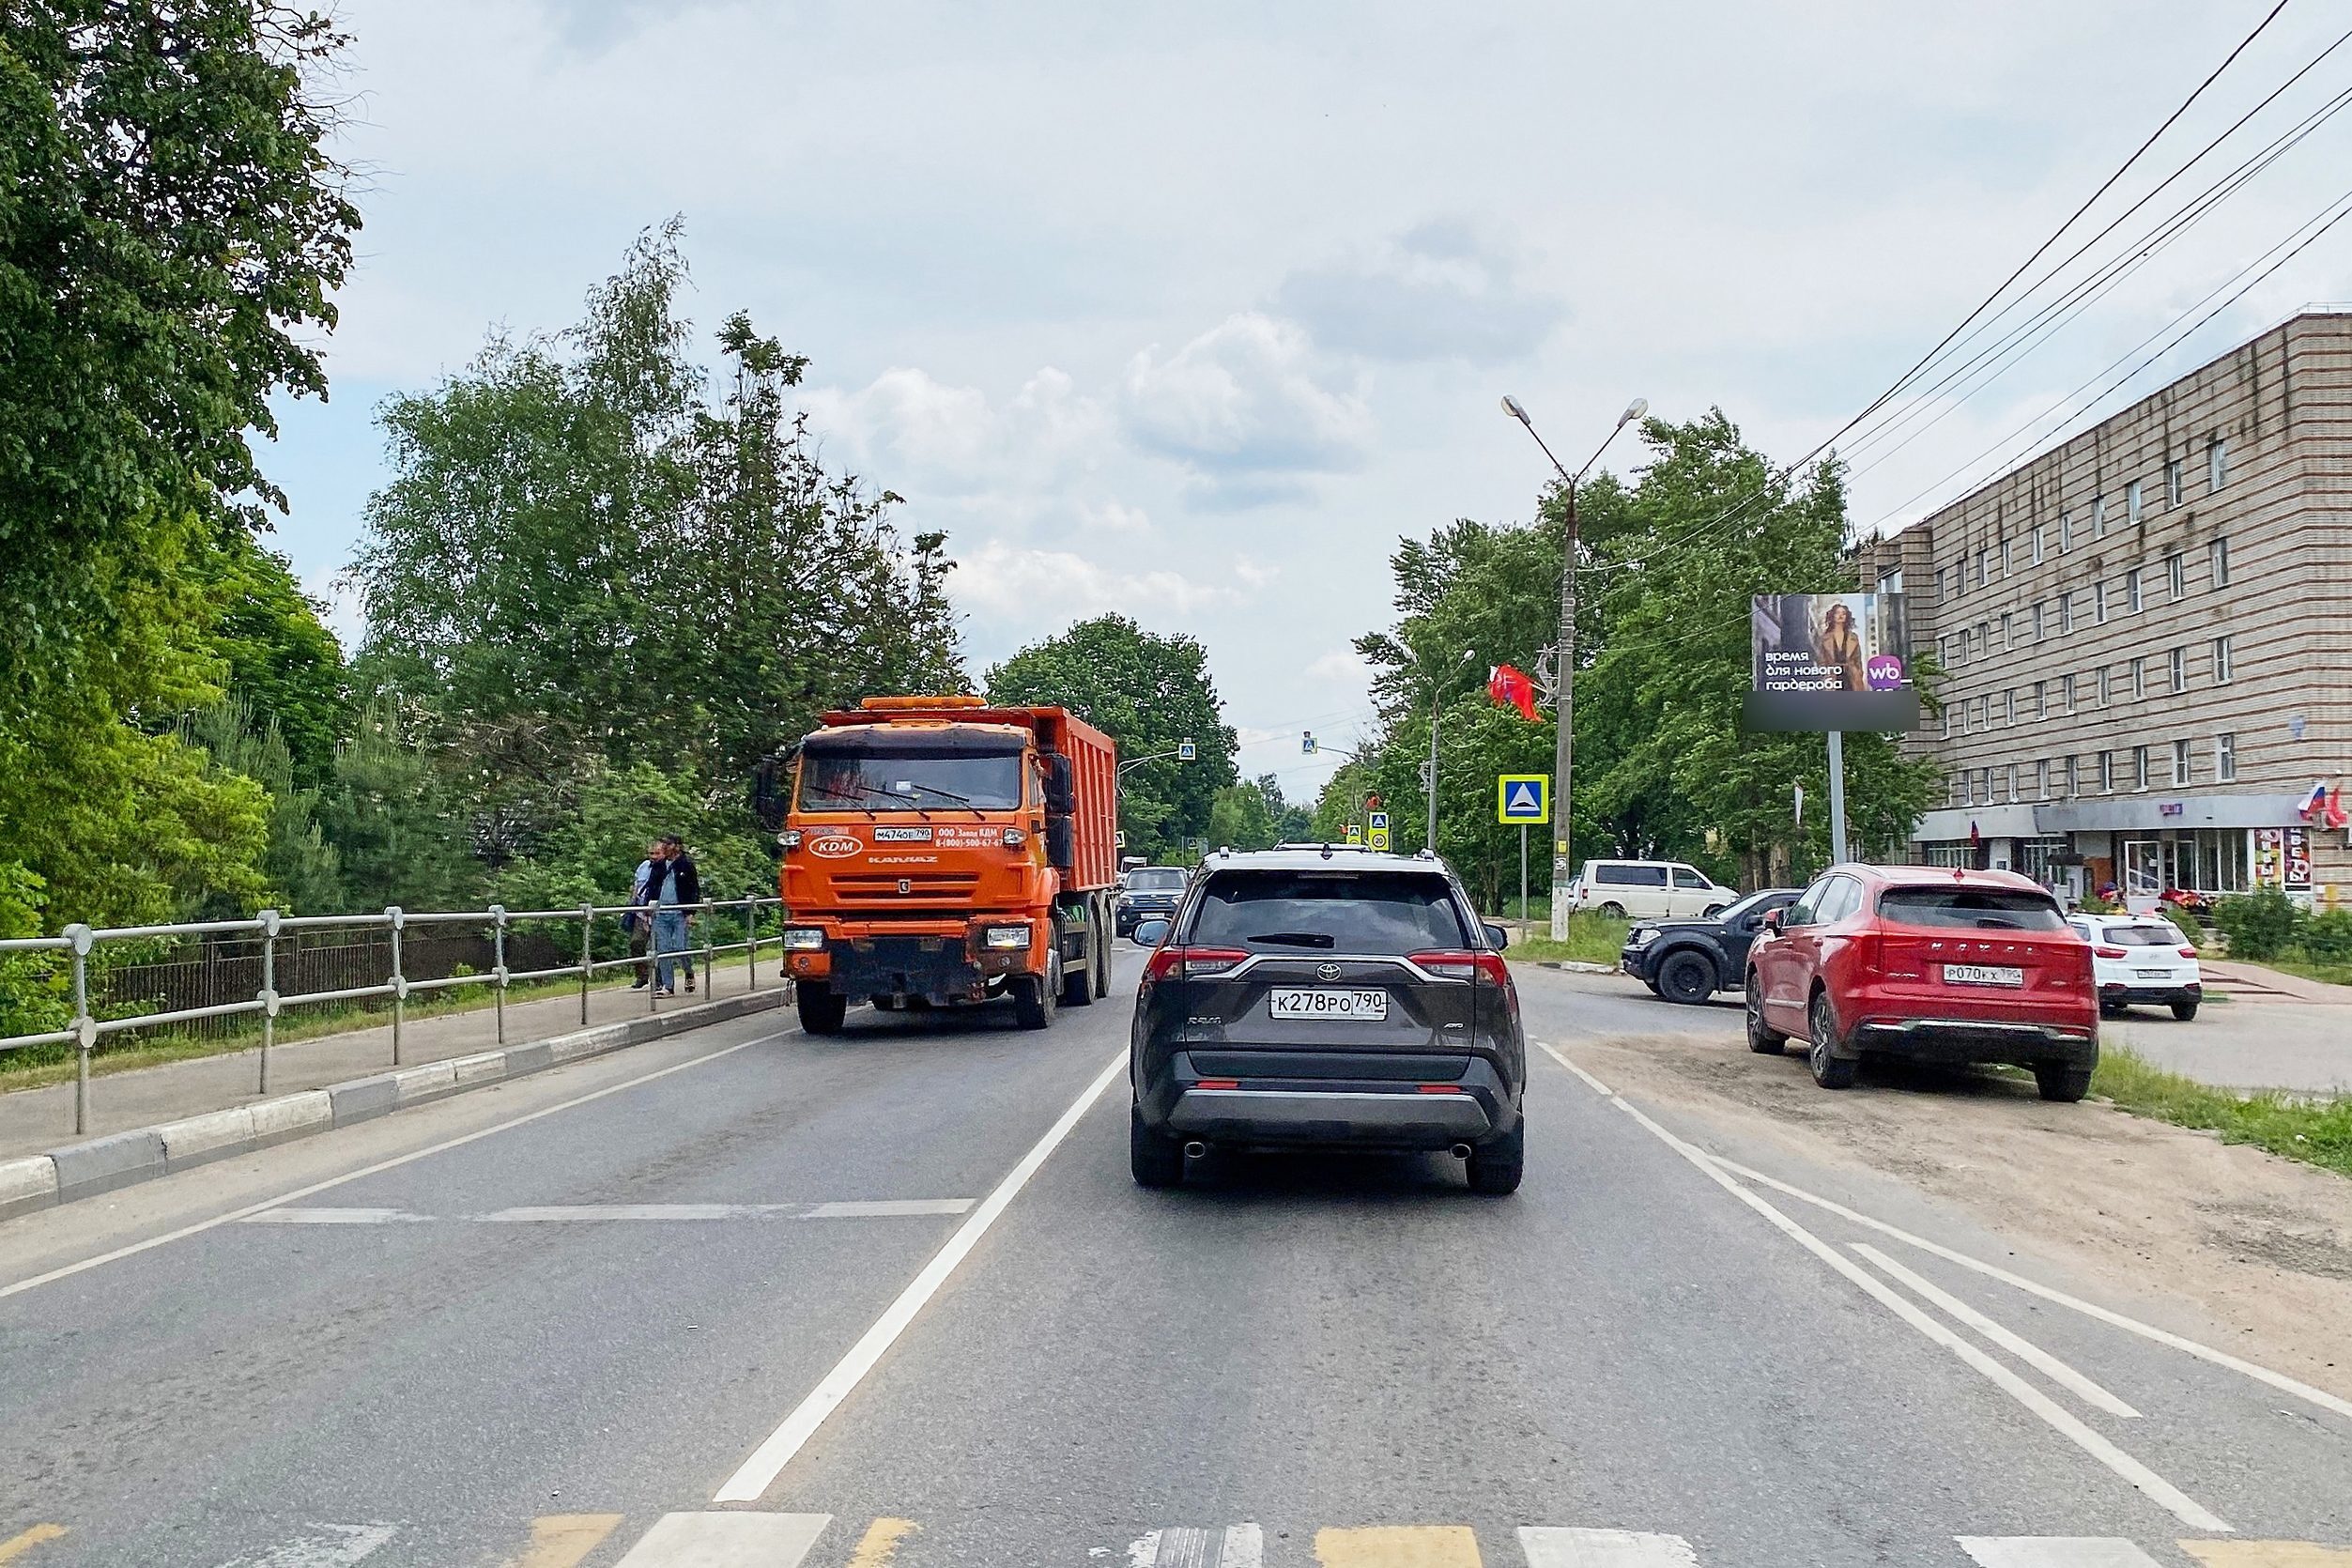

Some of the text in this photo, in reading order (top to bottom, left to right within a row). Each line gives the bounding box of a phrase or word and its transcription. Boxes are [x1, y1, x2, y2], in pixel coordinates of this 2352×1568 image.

[1765, 651, 1809, 664] время
[1765, 665, 1843, 676] для нового
[1868, 663, 1900, 680] wb
[1765, 678, 1843, 691] гардероба
[938, 828, 956, 838] ООО
[818, 841, 854, 852] KDM
